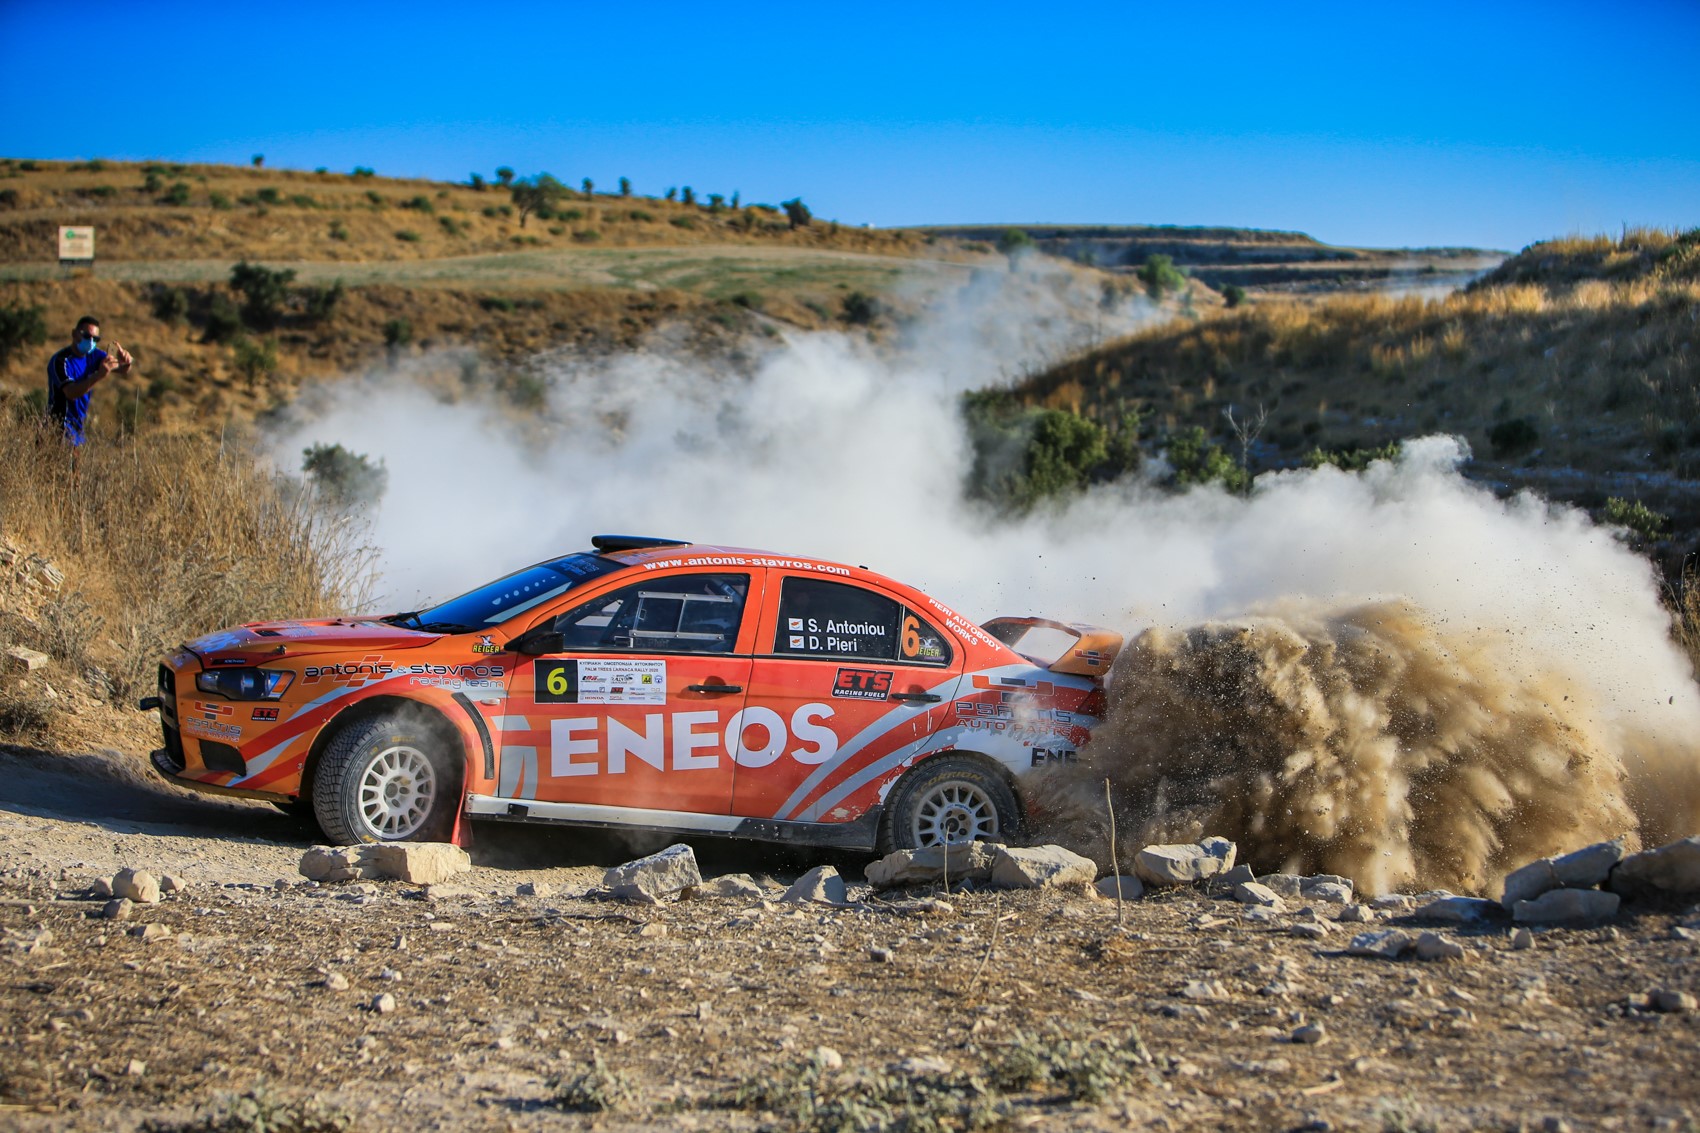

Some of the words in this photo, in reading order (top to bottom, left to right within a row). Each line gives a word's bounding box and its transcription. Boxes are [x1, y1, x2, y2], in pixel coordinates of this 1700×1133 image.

[644, 556, 850, 576] www.antonis-stavros.com
[808, 618, 822, 633] S.
[826, 619, 885, 636] Antoniou
[928, 598, 953, 617] PIERI
[952, 615, 1002, 652] AUTOBODY
[945, 618, 979, 646] WORKS
[809, 636, 823, 650] D.
[827, 636, 858, 652] Pieri
[902, 615, 920, 658] 6
[473, 644, 500, 653] REIGER
[916, 647, 940, 657] EIGER
[304, 661, 394, 677] antonis
[410, 662, 504, 677] stavros
[409, 674, 462, 690] racing
[464, 677, 505, 689] team
[546, 667, 568, 695] 6
[837, 670, 891, 691] ETS
[864, 691, 886, 699] FUELS
[253, 708, 278, 717] ETS
[956, 719, 1007, 731] AUTO
[1013, 725, 1073, 738] PARTS
[551, 702, 839, 777] ENEOS
